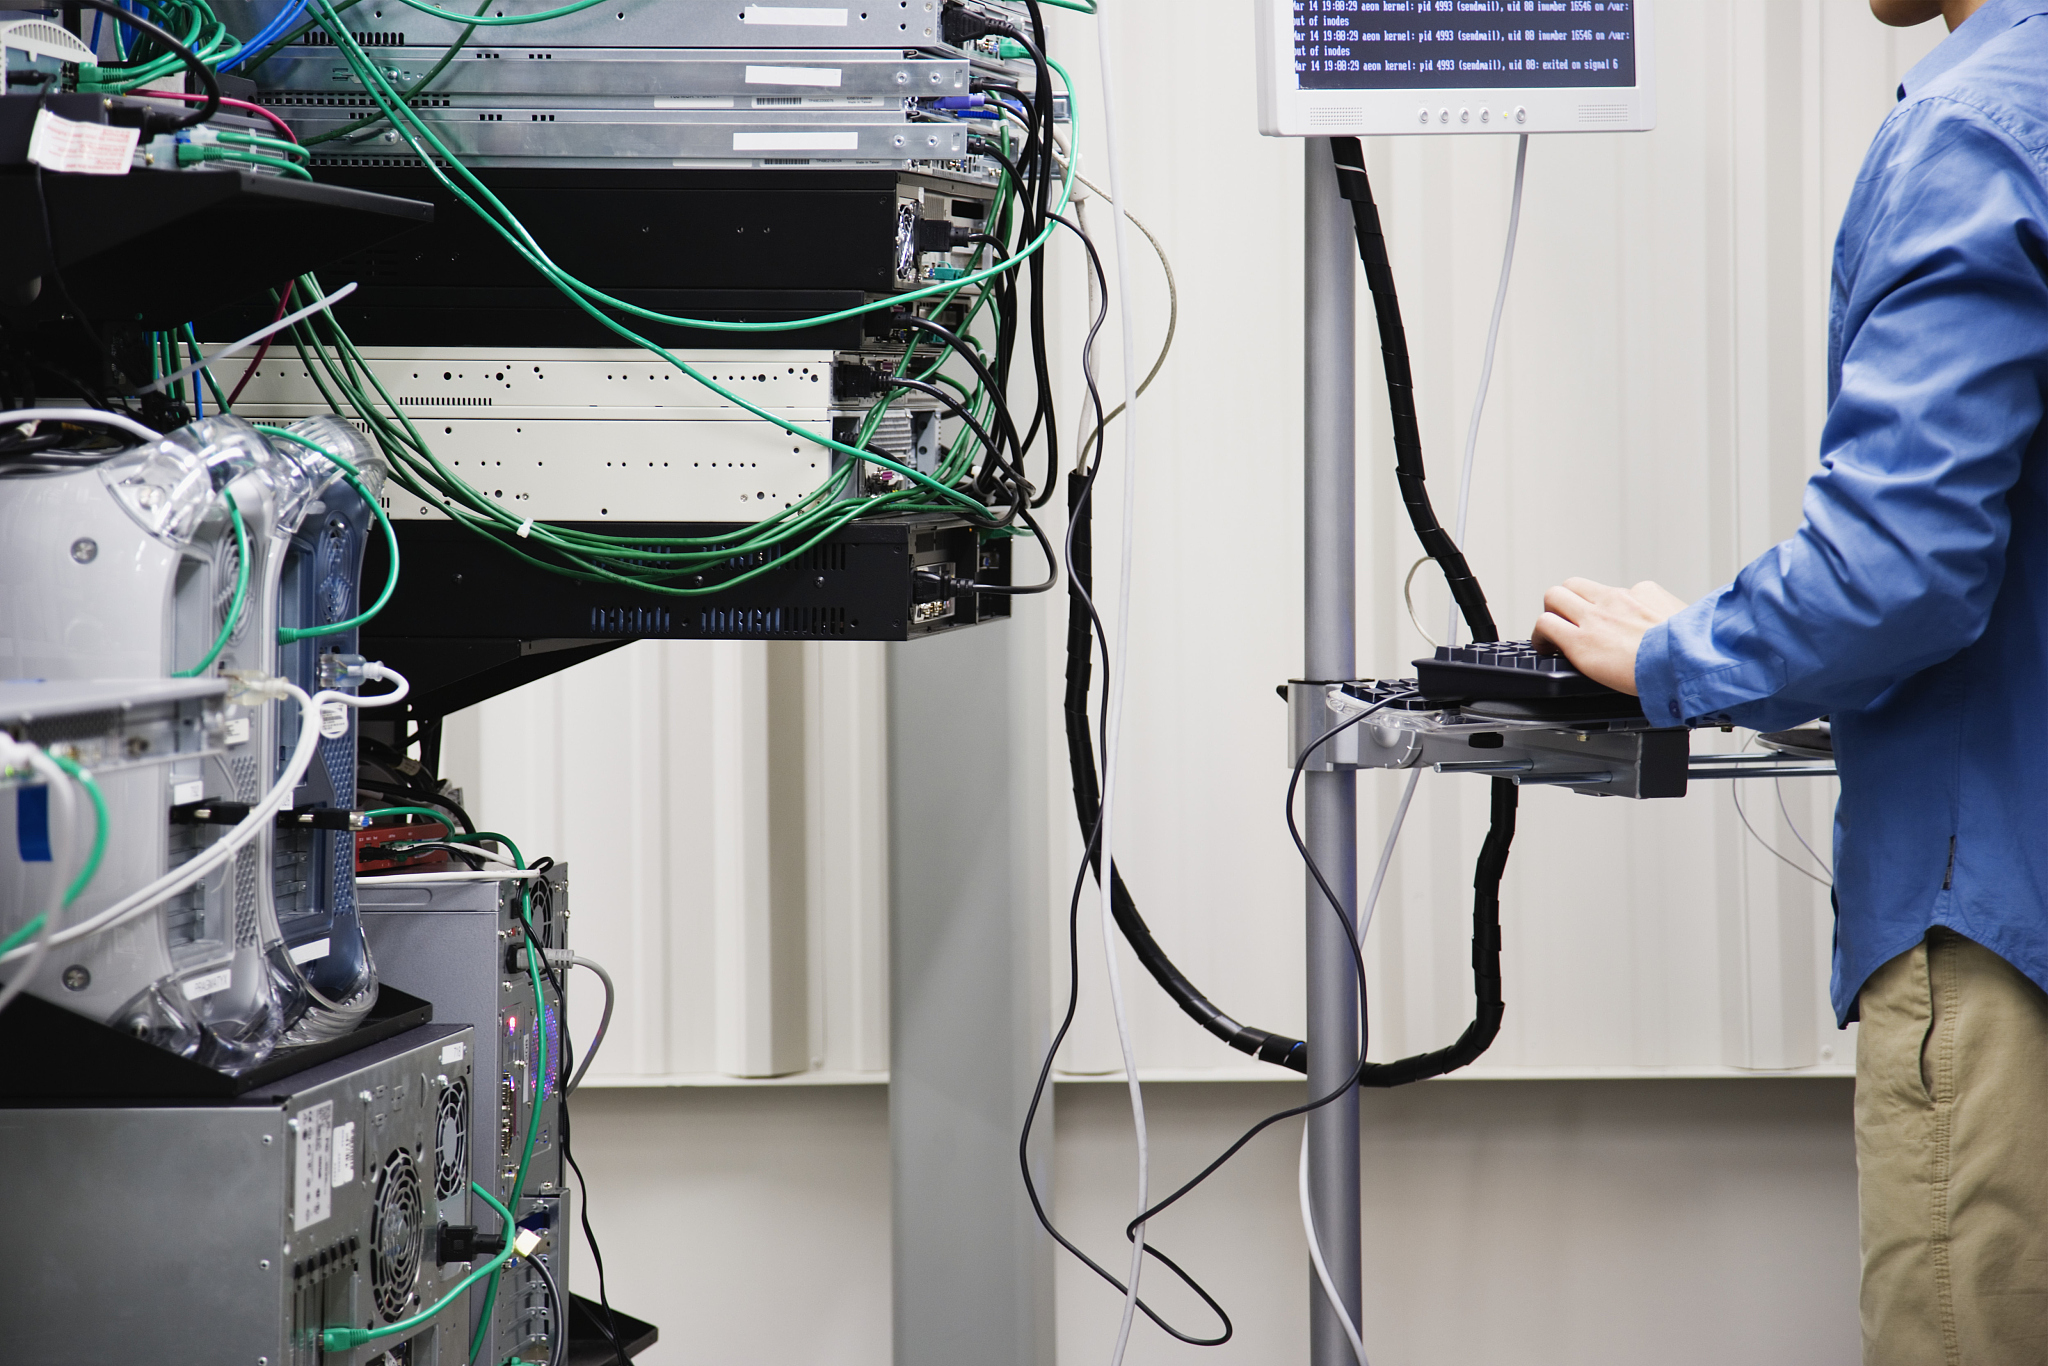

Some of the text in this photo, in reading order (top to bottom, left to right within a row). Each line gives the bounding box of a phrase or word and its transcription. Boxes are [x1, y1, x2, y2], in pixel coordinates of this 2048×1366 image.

[1361, 0, 1379, 11] aeon
[1383, 0, 1413, 11] kernel:
[1418, 0, 1431, 13] pid
[1435, 0, 1453, 11] 4993
[1457, 0, 1503, 13] (sendmail),
[1507, 0, 1520, 11] uid
[1538, 0, 1566, 11] inumber
[1571, 0, 1591, 11] 16546
[1607, 0, 1628, 11] /var:
[1323, 15, 1349, 26] inodes
[1362, 30, 1380, 41] aeon
[1384, 30, 1414, 41] kernel:
[1419, 30, 1432, 43] pid
[1436, 30, 1453, 41] 4993
[1458, 30, 1504, 43] (sendmail),
[1508, 30, 1521, 41] uid
[1539, 30, 1567, 41] inumber
[1572, 30, 1592, 41] 16546
[1608, 30, 1629, 41] /var:
[1324, 45, 1350, 56] inodes
[1363, 60, 1381, 71] aeon
[1385, 60, 1415, 71] kernel:
[1420, 60, 1433, 73] pid
[1437, 60, 1454, 71] 4993
[1459, 59, 1505, 72] (sendmail),
[1509, 59, 1522, 70] uid
[1543, 59, 1568, 70] exited
[1584, 59, 1609, 71] signal
